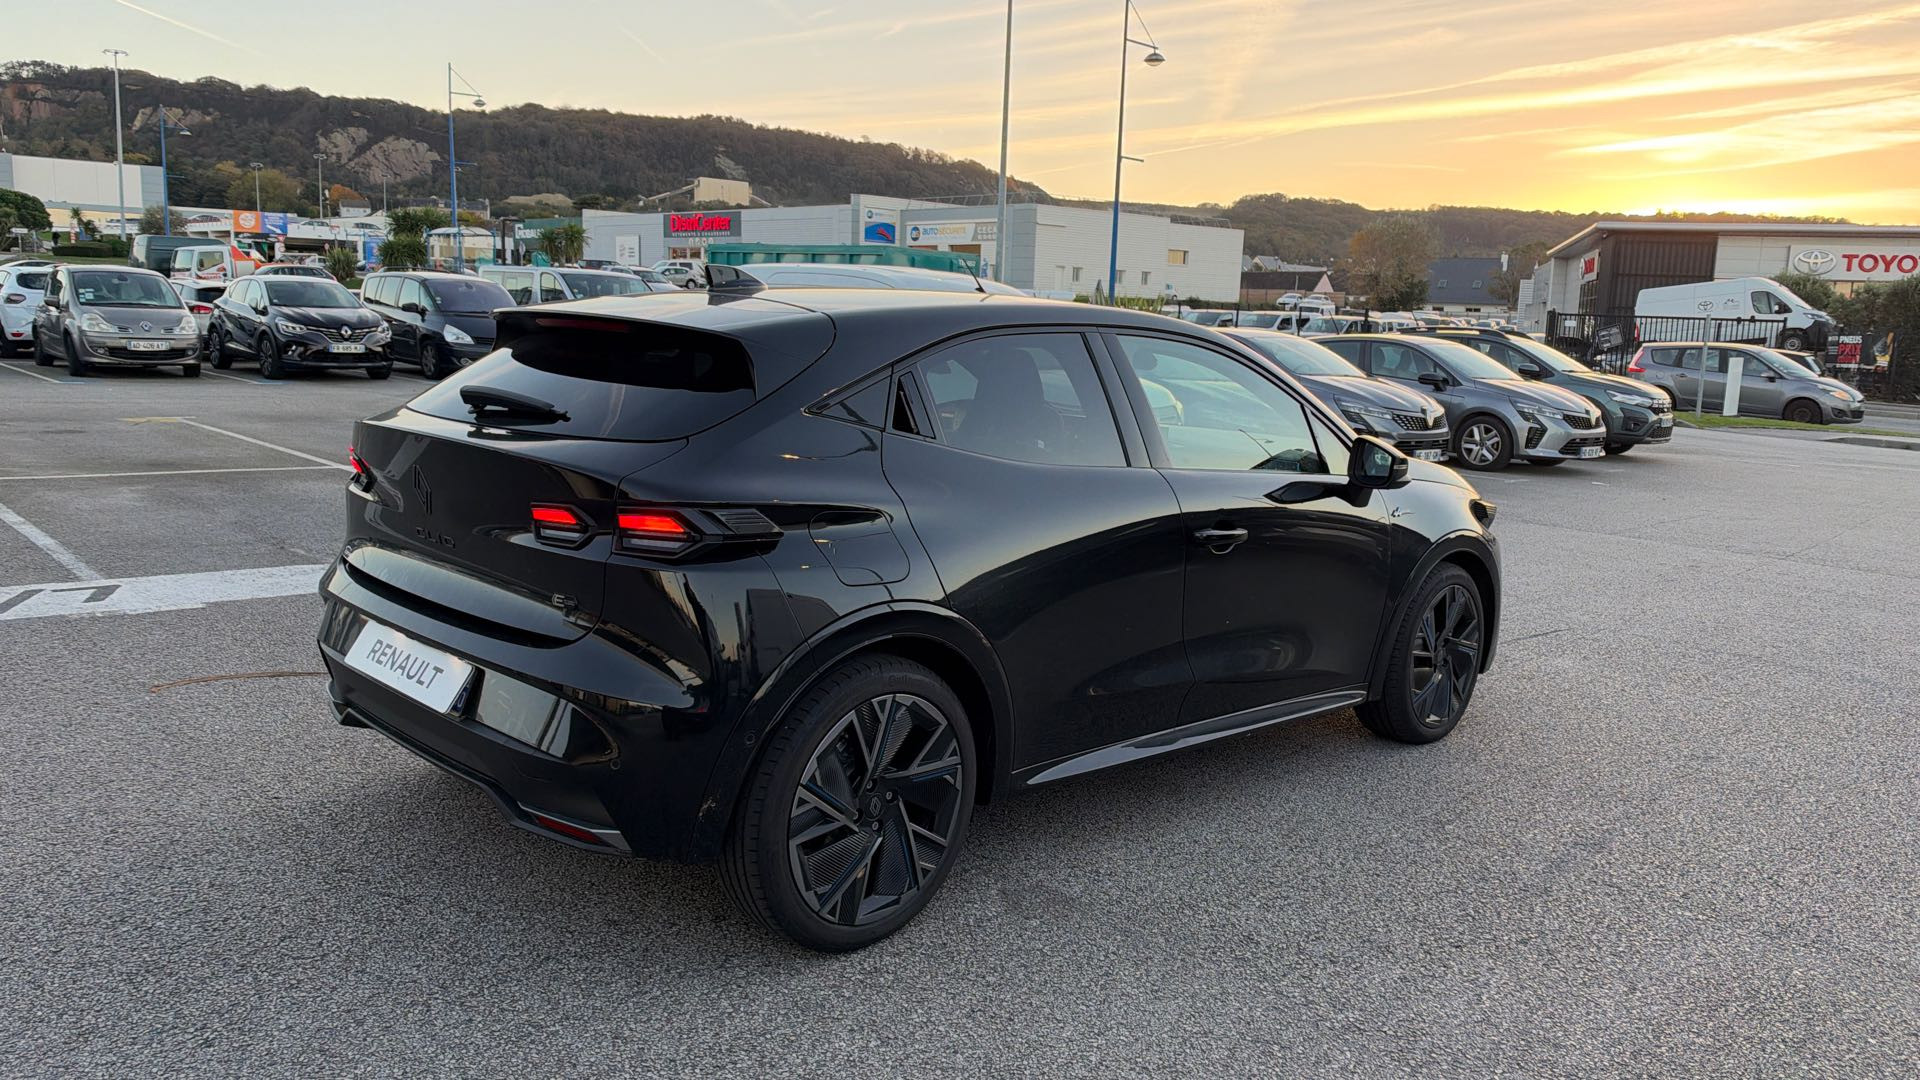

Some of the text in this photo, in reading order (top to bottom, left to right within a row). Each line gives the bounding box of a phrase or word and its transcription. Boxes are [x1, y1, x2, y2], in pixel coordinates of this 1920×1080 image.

[1841, 254, 1920, 273] TOYO
[1839, 335, 1862, 344] PNEUS
[1838, 344, 1862, 355] PRIX
[366, 639, 444, 689] RENAULT
